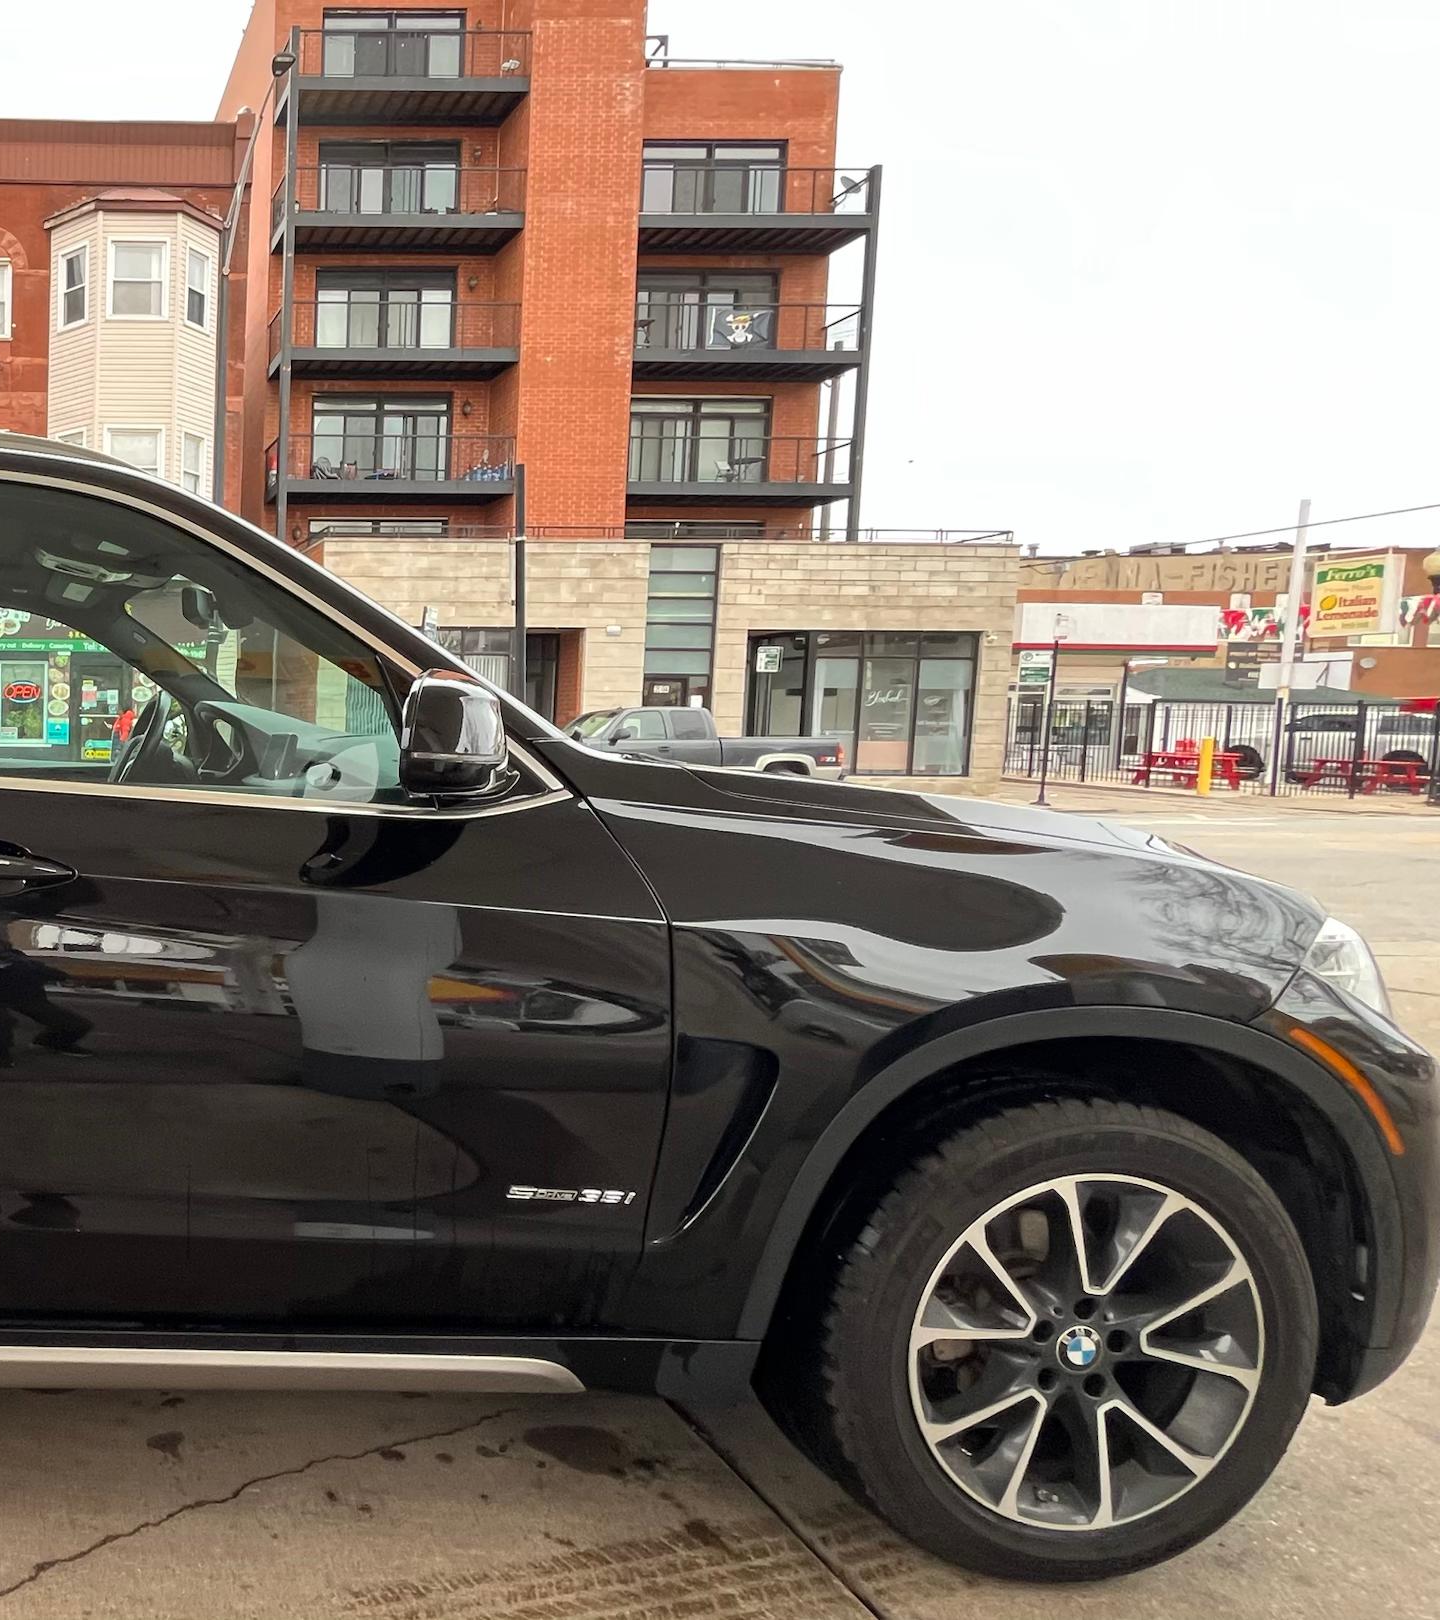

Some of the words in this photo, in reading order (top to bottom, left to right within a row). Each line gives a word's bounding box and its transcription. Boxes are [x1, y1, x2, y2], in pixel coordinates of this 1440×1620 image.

[1326, 564, 1377, 581] Ferro's
[1339, 595, 1376, 607] Italian
[1316, 607, 1378, 621] Lemonade
[22, 642, 45, 650] Delivery
[3, 685, 41, 699] OPEN
